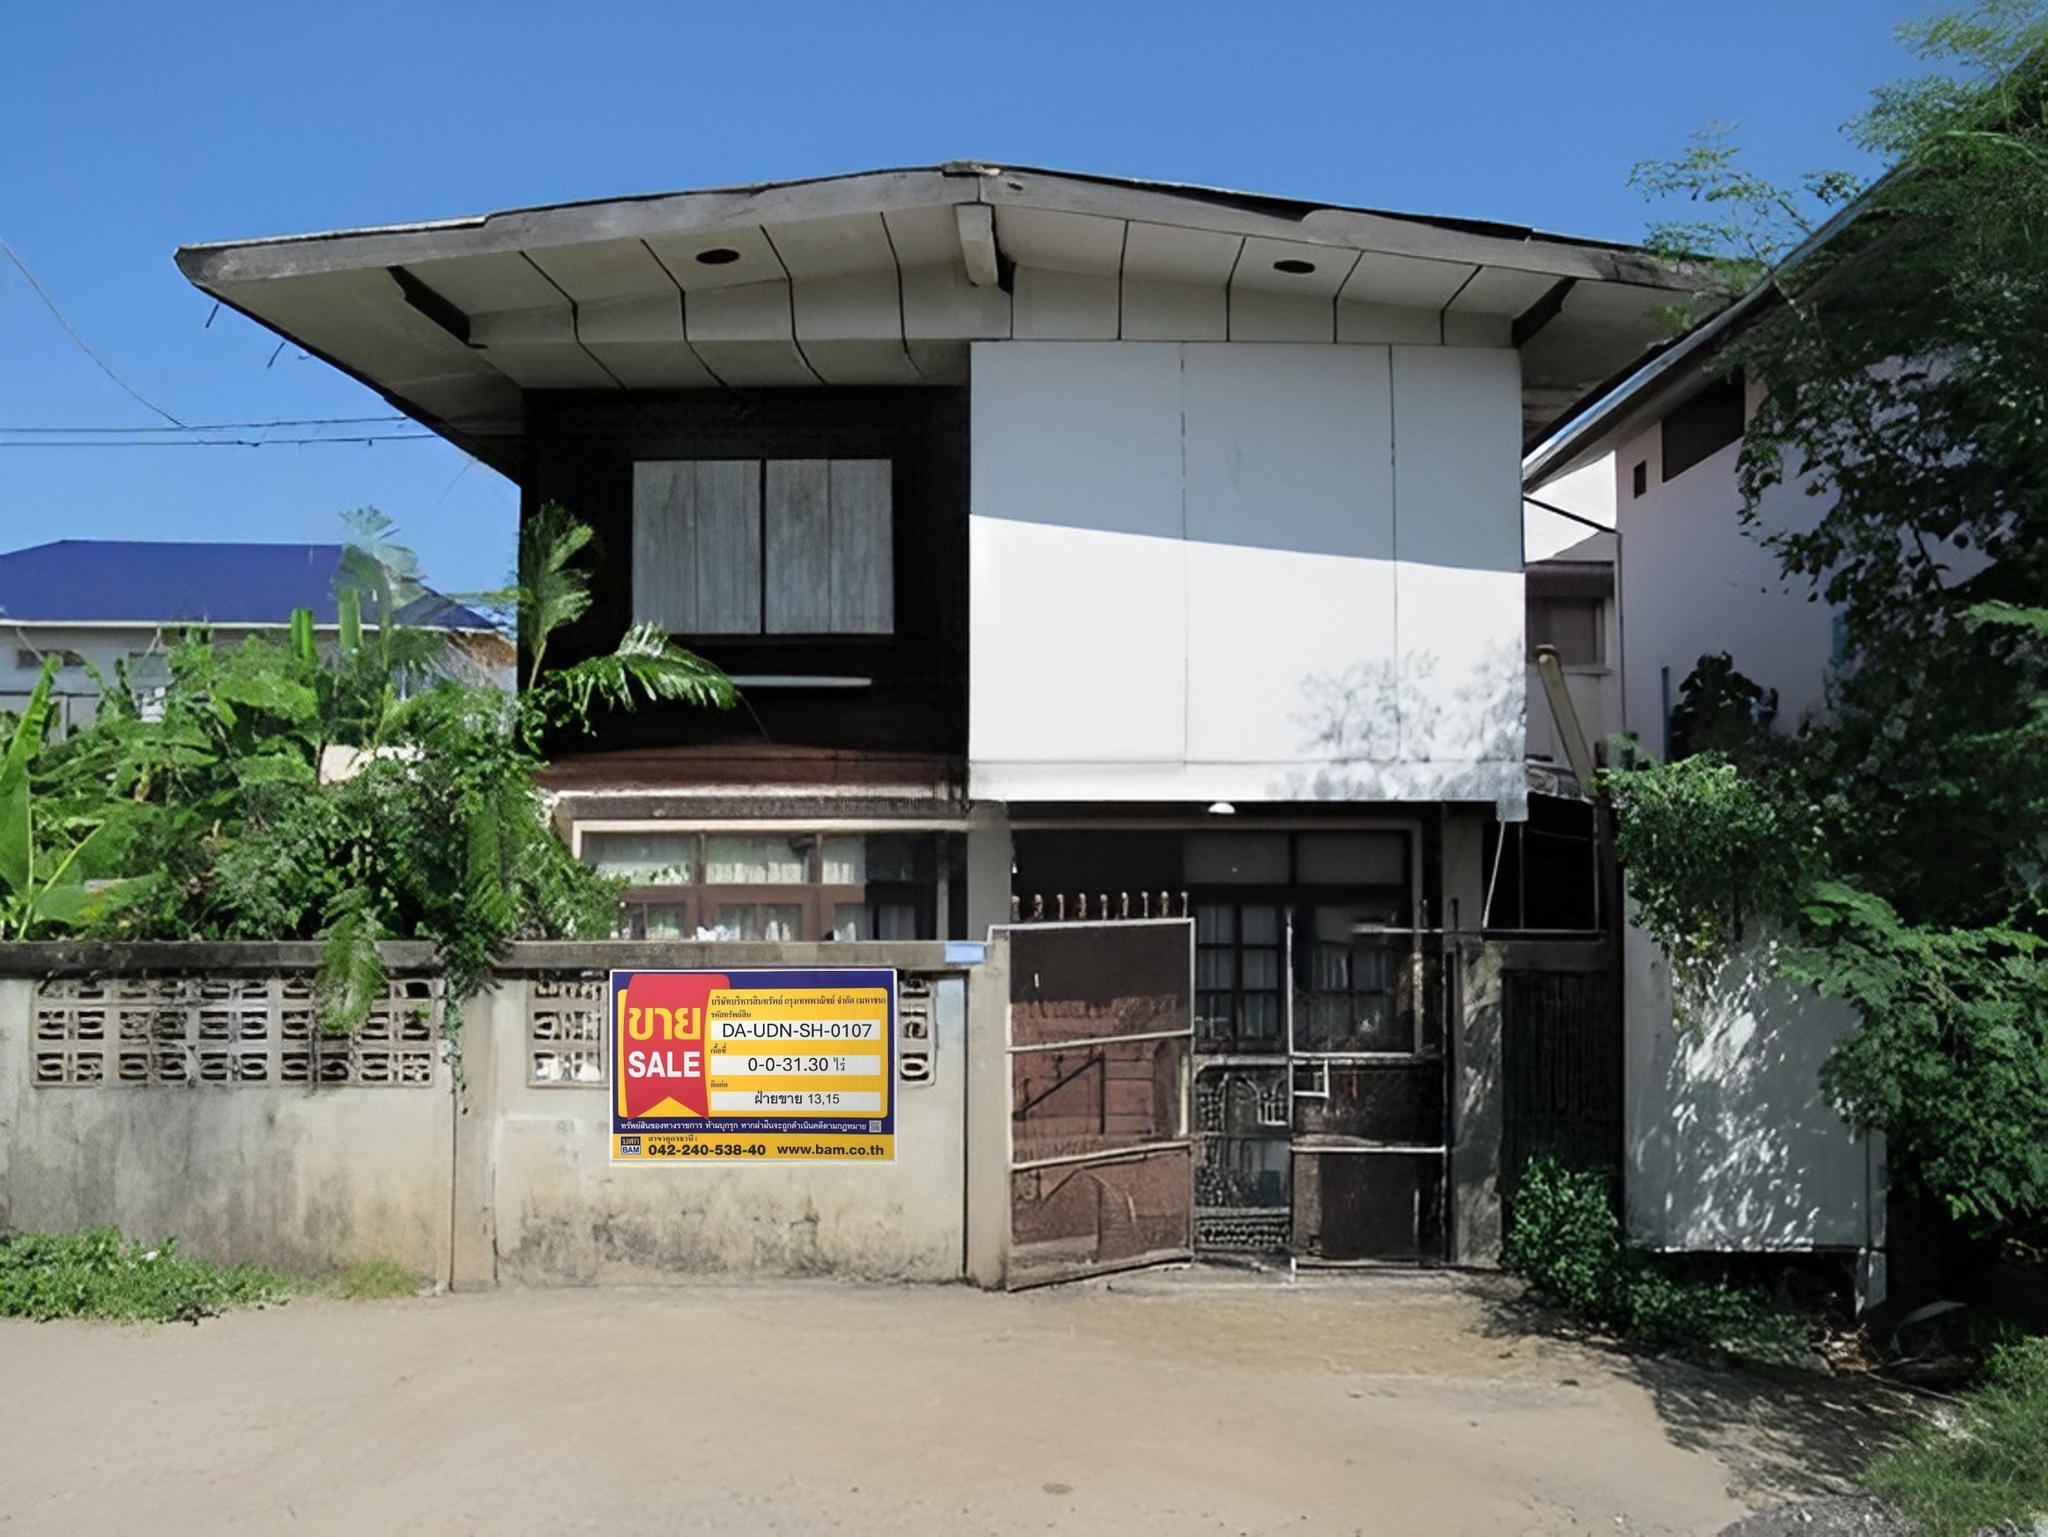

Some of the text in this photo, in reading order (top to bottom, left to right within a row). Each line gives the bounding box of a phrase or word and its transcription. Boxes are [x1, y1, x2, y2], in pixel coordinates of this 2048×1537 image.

[856, 997, 886, 1006] (มหาชน)
[628, 1007, 701, 1040] ขาย
[722, 1023, 873, 1038] DA-UDN-SH-0107
[628, 1050, 701, 1078] SALE
[748, 1056, 846, 1072] 0-0-31.30 ไร่
[755, 1091, 840, 1106] ฝ่ายขาย 13,15
[622, 1146, 640, 1154] BAM
[648, 1144, 884, 1156] 042-240-538-40 www.bam.co.th
